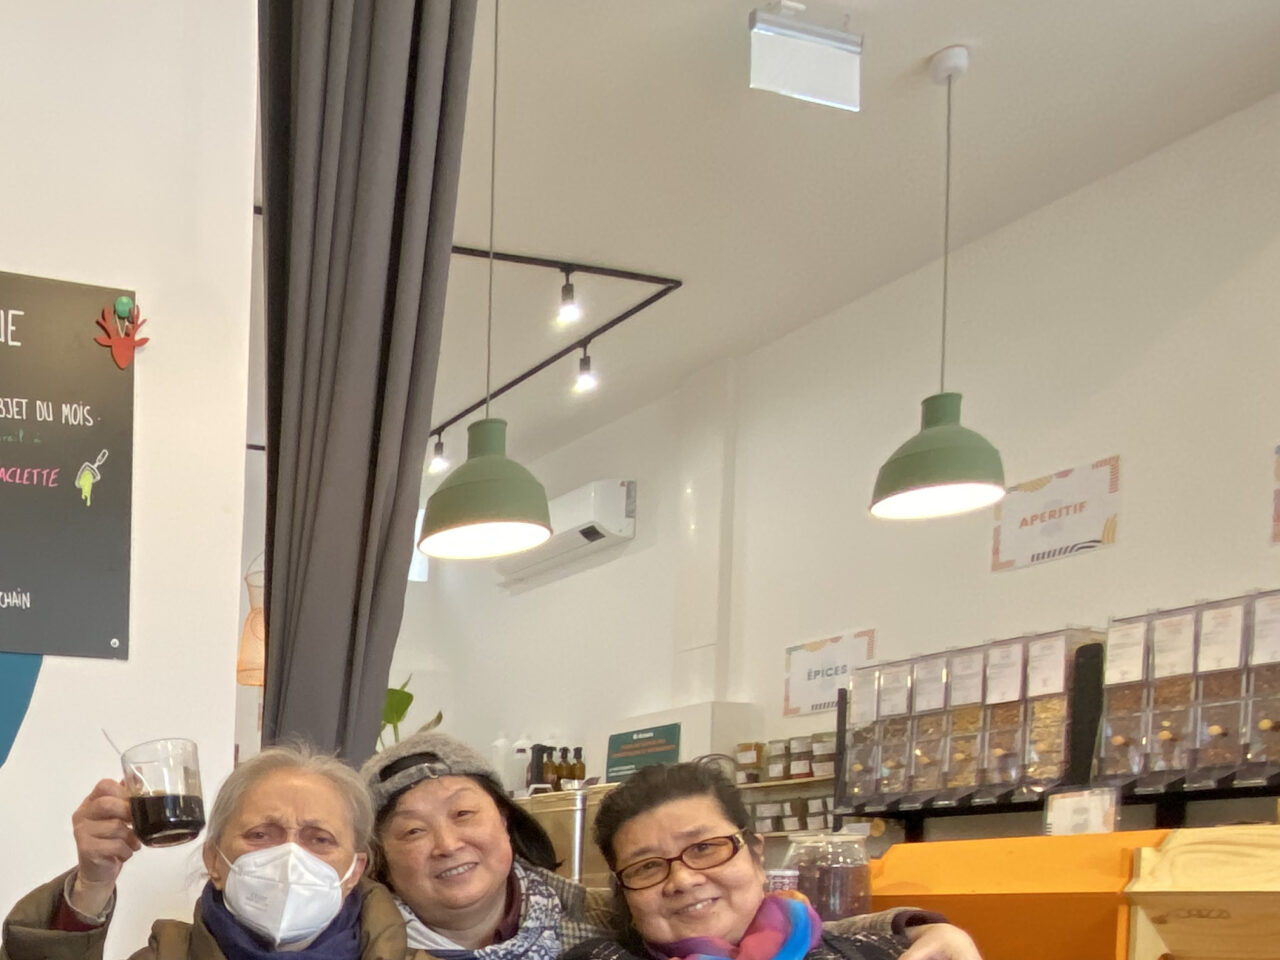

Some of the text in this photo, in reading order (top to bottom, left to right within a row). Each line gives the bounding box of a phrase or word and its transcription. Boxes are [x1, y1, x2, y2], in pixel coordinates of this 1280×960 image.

[36, 402, 53, 422] DU
[1018, 500, 1087, 529] APERITIF
[806, 664, 848, 681] ÉPICES
